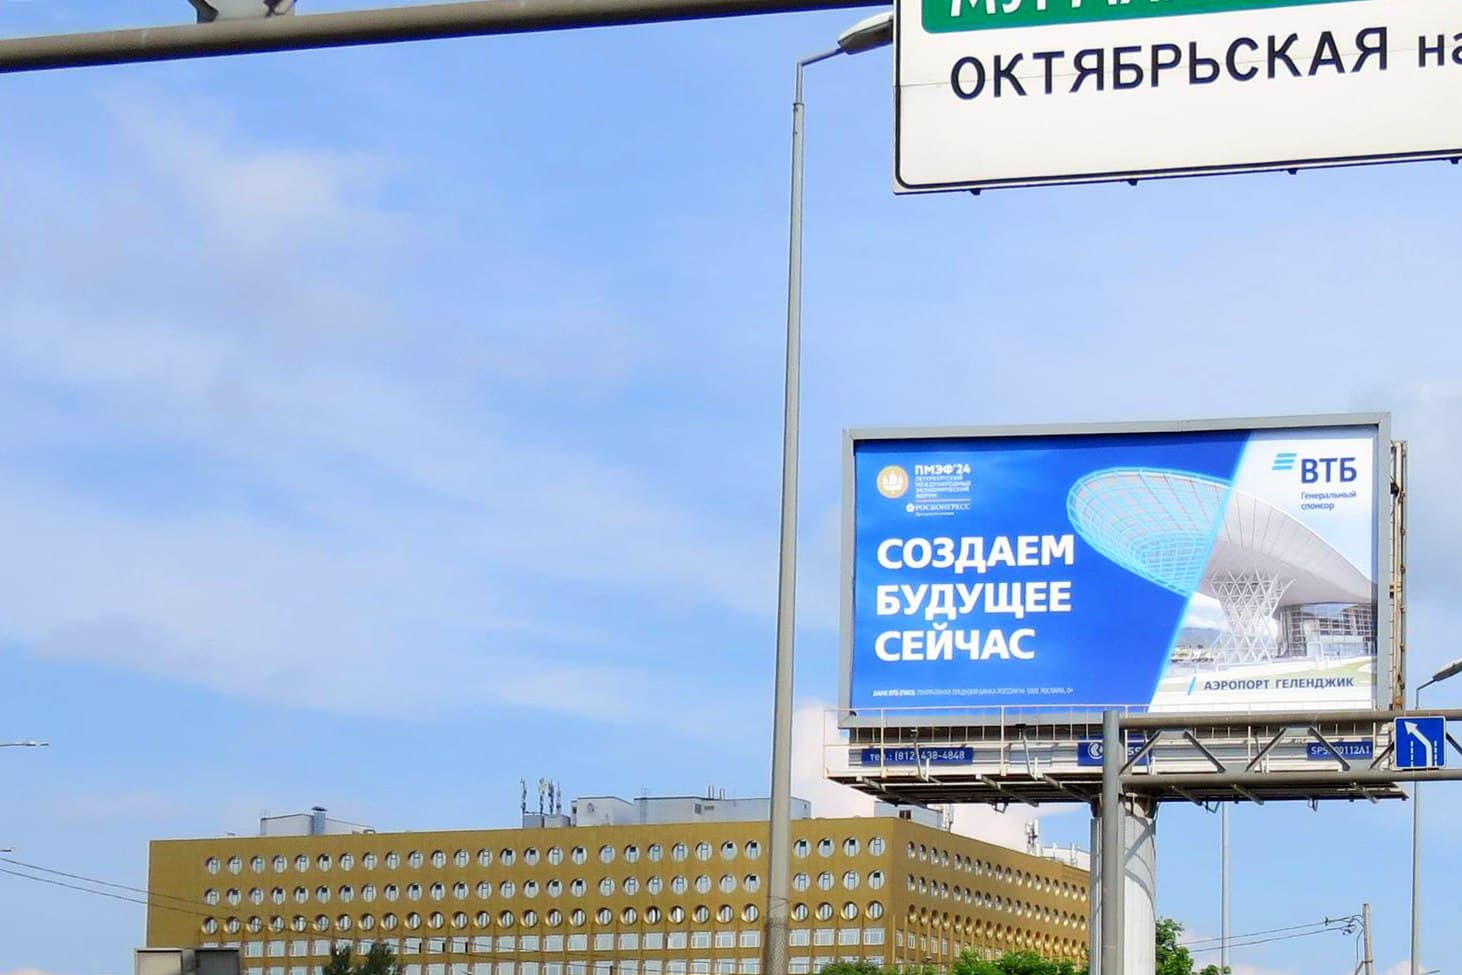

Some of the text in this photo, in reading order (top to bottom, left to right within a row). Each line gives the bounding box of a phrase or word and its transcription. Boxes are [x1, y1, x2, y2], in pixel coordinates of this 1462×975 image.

[950, 26, 1388, 101] ОКТЯБРЬСКАЯ
[1301, 457, 1357, 484] ВТБ
[1301, 490, 1357, 500] Генеральный
[1301, 502, 1335, 511] спонсор
[876, 534, 1075, 574] СОЗДАЕМ
[876, 581, 1072, 621] БУДУЩЕЕ
[874, 621, 1036, 662] СЕЙЧАС
[1204, 677, 1354, 690] АЭРОПОРТ ГЕЛЕНДЖИК
